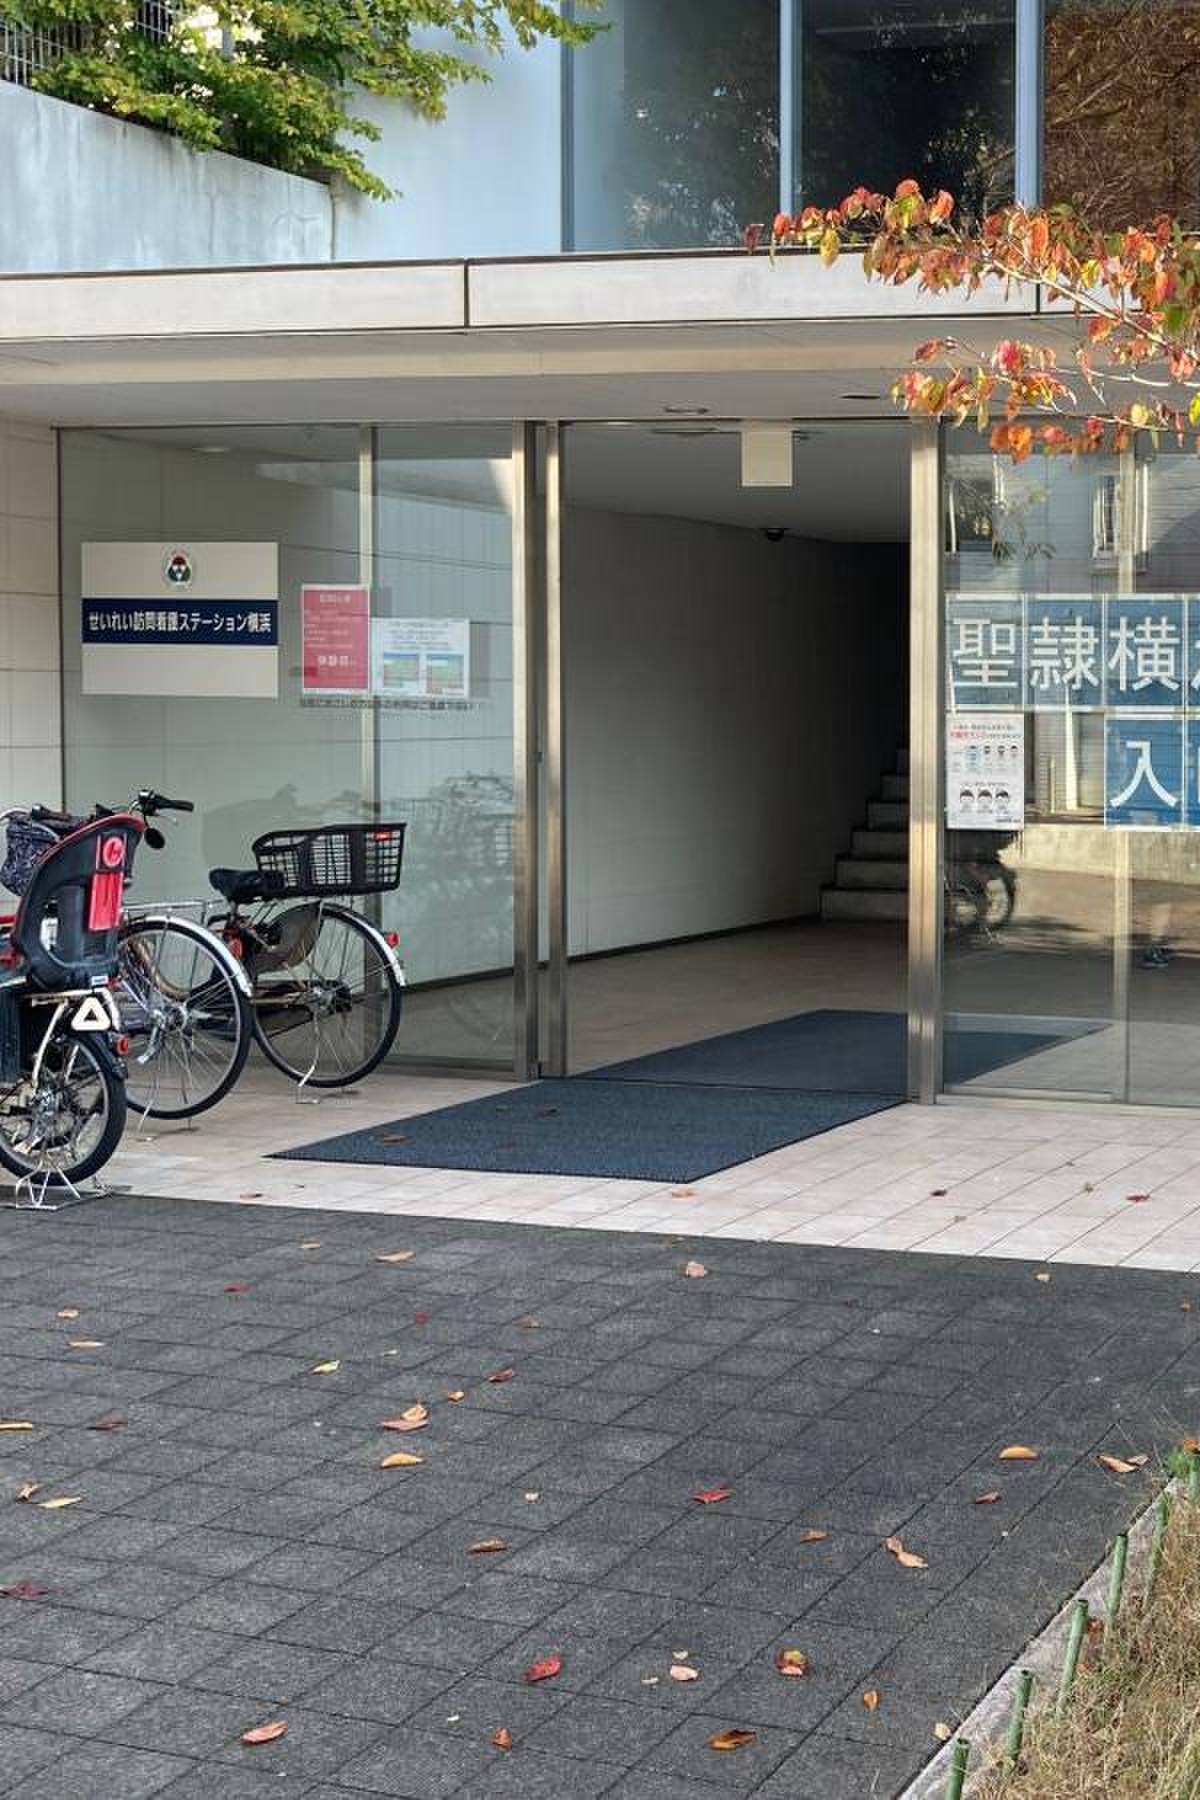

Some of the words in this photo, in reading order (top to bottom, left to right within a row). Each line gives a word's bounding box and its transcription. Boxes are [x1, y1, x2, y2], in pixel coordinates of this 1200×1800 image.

[89, 611, 272, 633] せいれい訪問看護ステーション横浜
